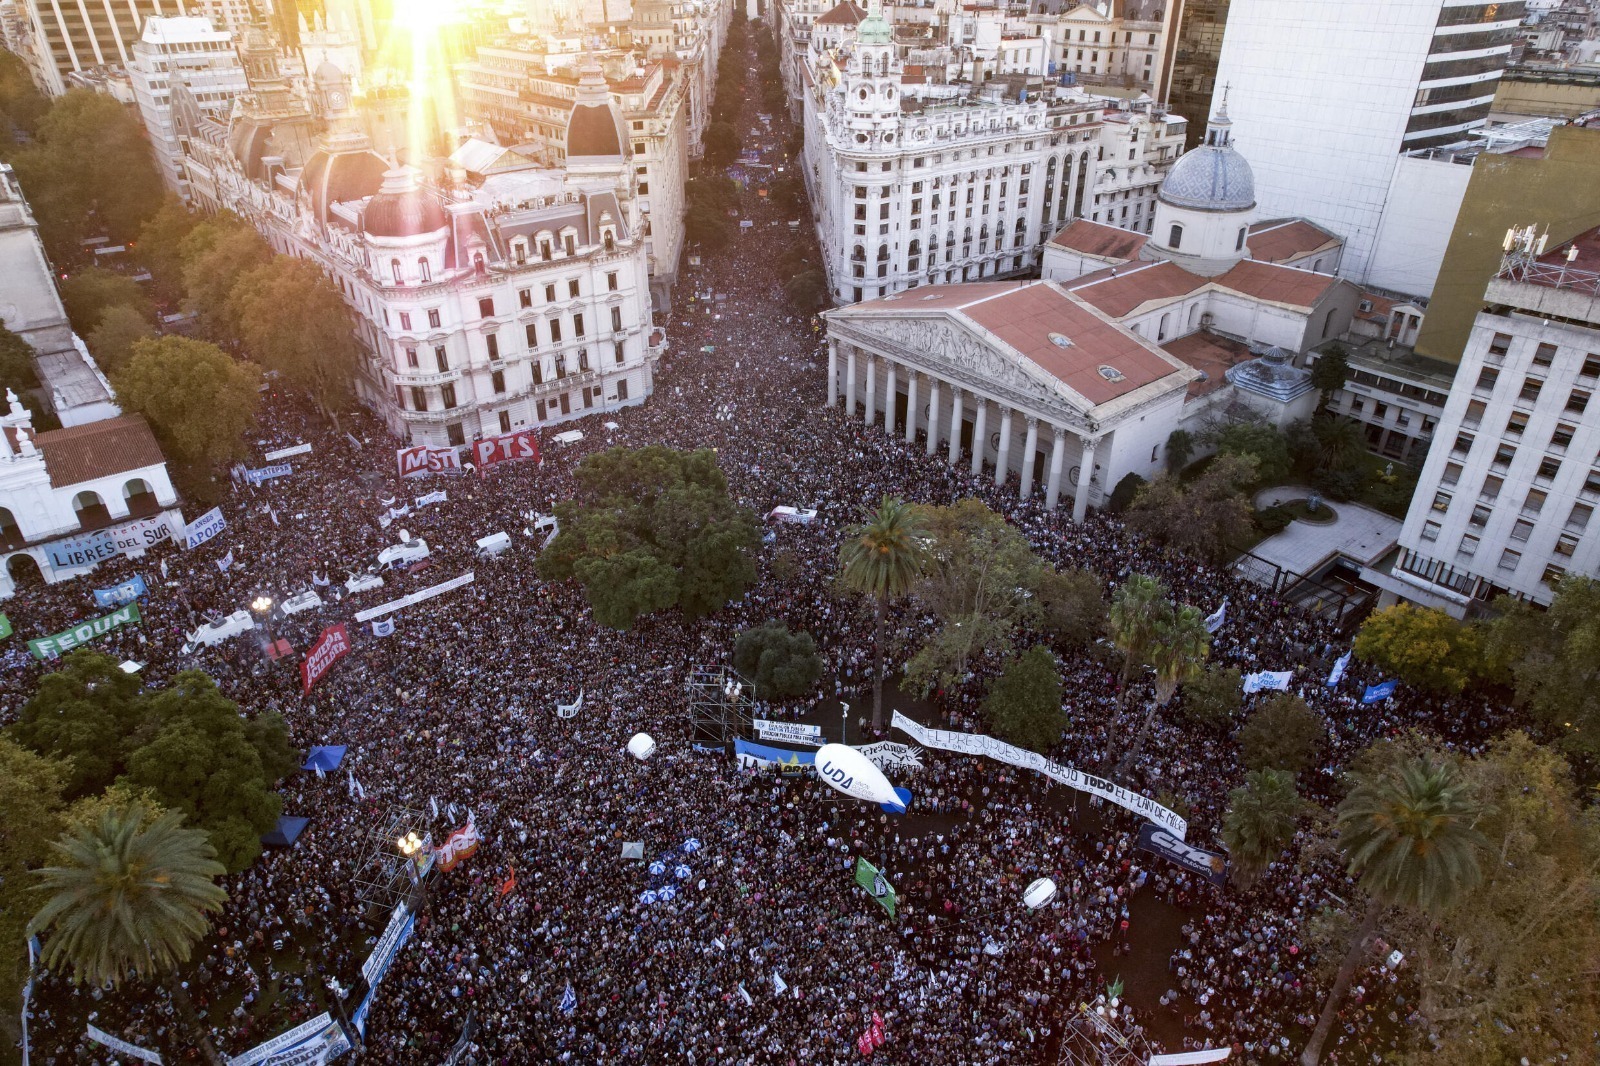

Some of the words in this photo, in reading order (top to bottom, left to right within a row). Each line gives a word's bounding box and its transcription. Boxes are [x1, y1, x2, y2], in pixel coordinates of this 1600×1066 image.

[405, 449, 453, 471] MST
[478, 436, 534, 464] PTS
[190, 518, 226, 547] APOPS
[194, 513, 214, 530] ANSES
[117, 538, 140, 549] DEL
[143, 523, 171, 545] SUR
[35, 608, 131, 657] FEDUN
[822, 761, 854, 789] UDA
[928, 730, 941, 742] EL
[1044, 760, 1078, 782] ABAJO
[1082, 773, 1115, 793] TODO
[1115, 788, 1127, 800] EL
[1130, 793, 1154, 814] PLAN
[1154, 805, 1167, 819] DE
[1151, 831, 1213, 867] CTA
[1182, 857, 1212, 877] autónom
